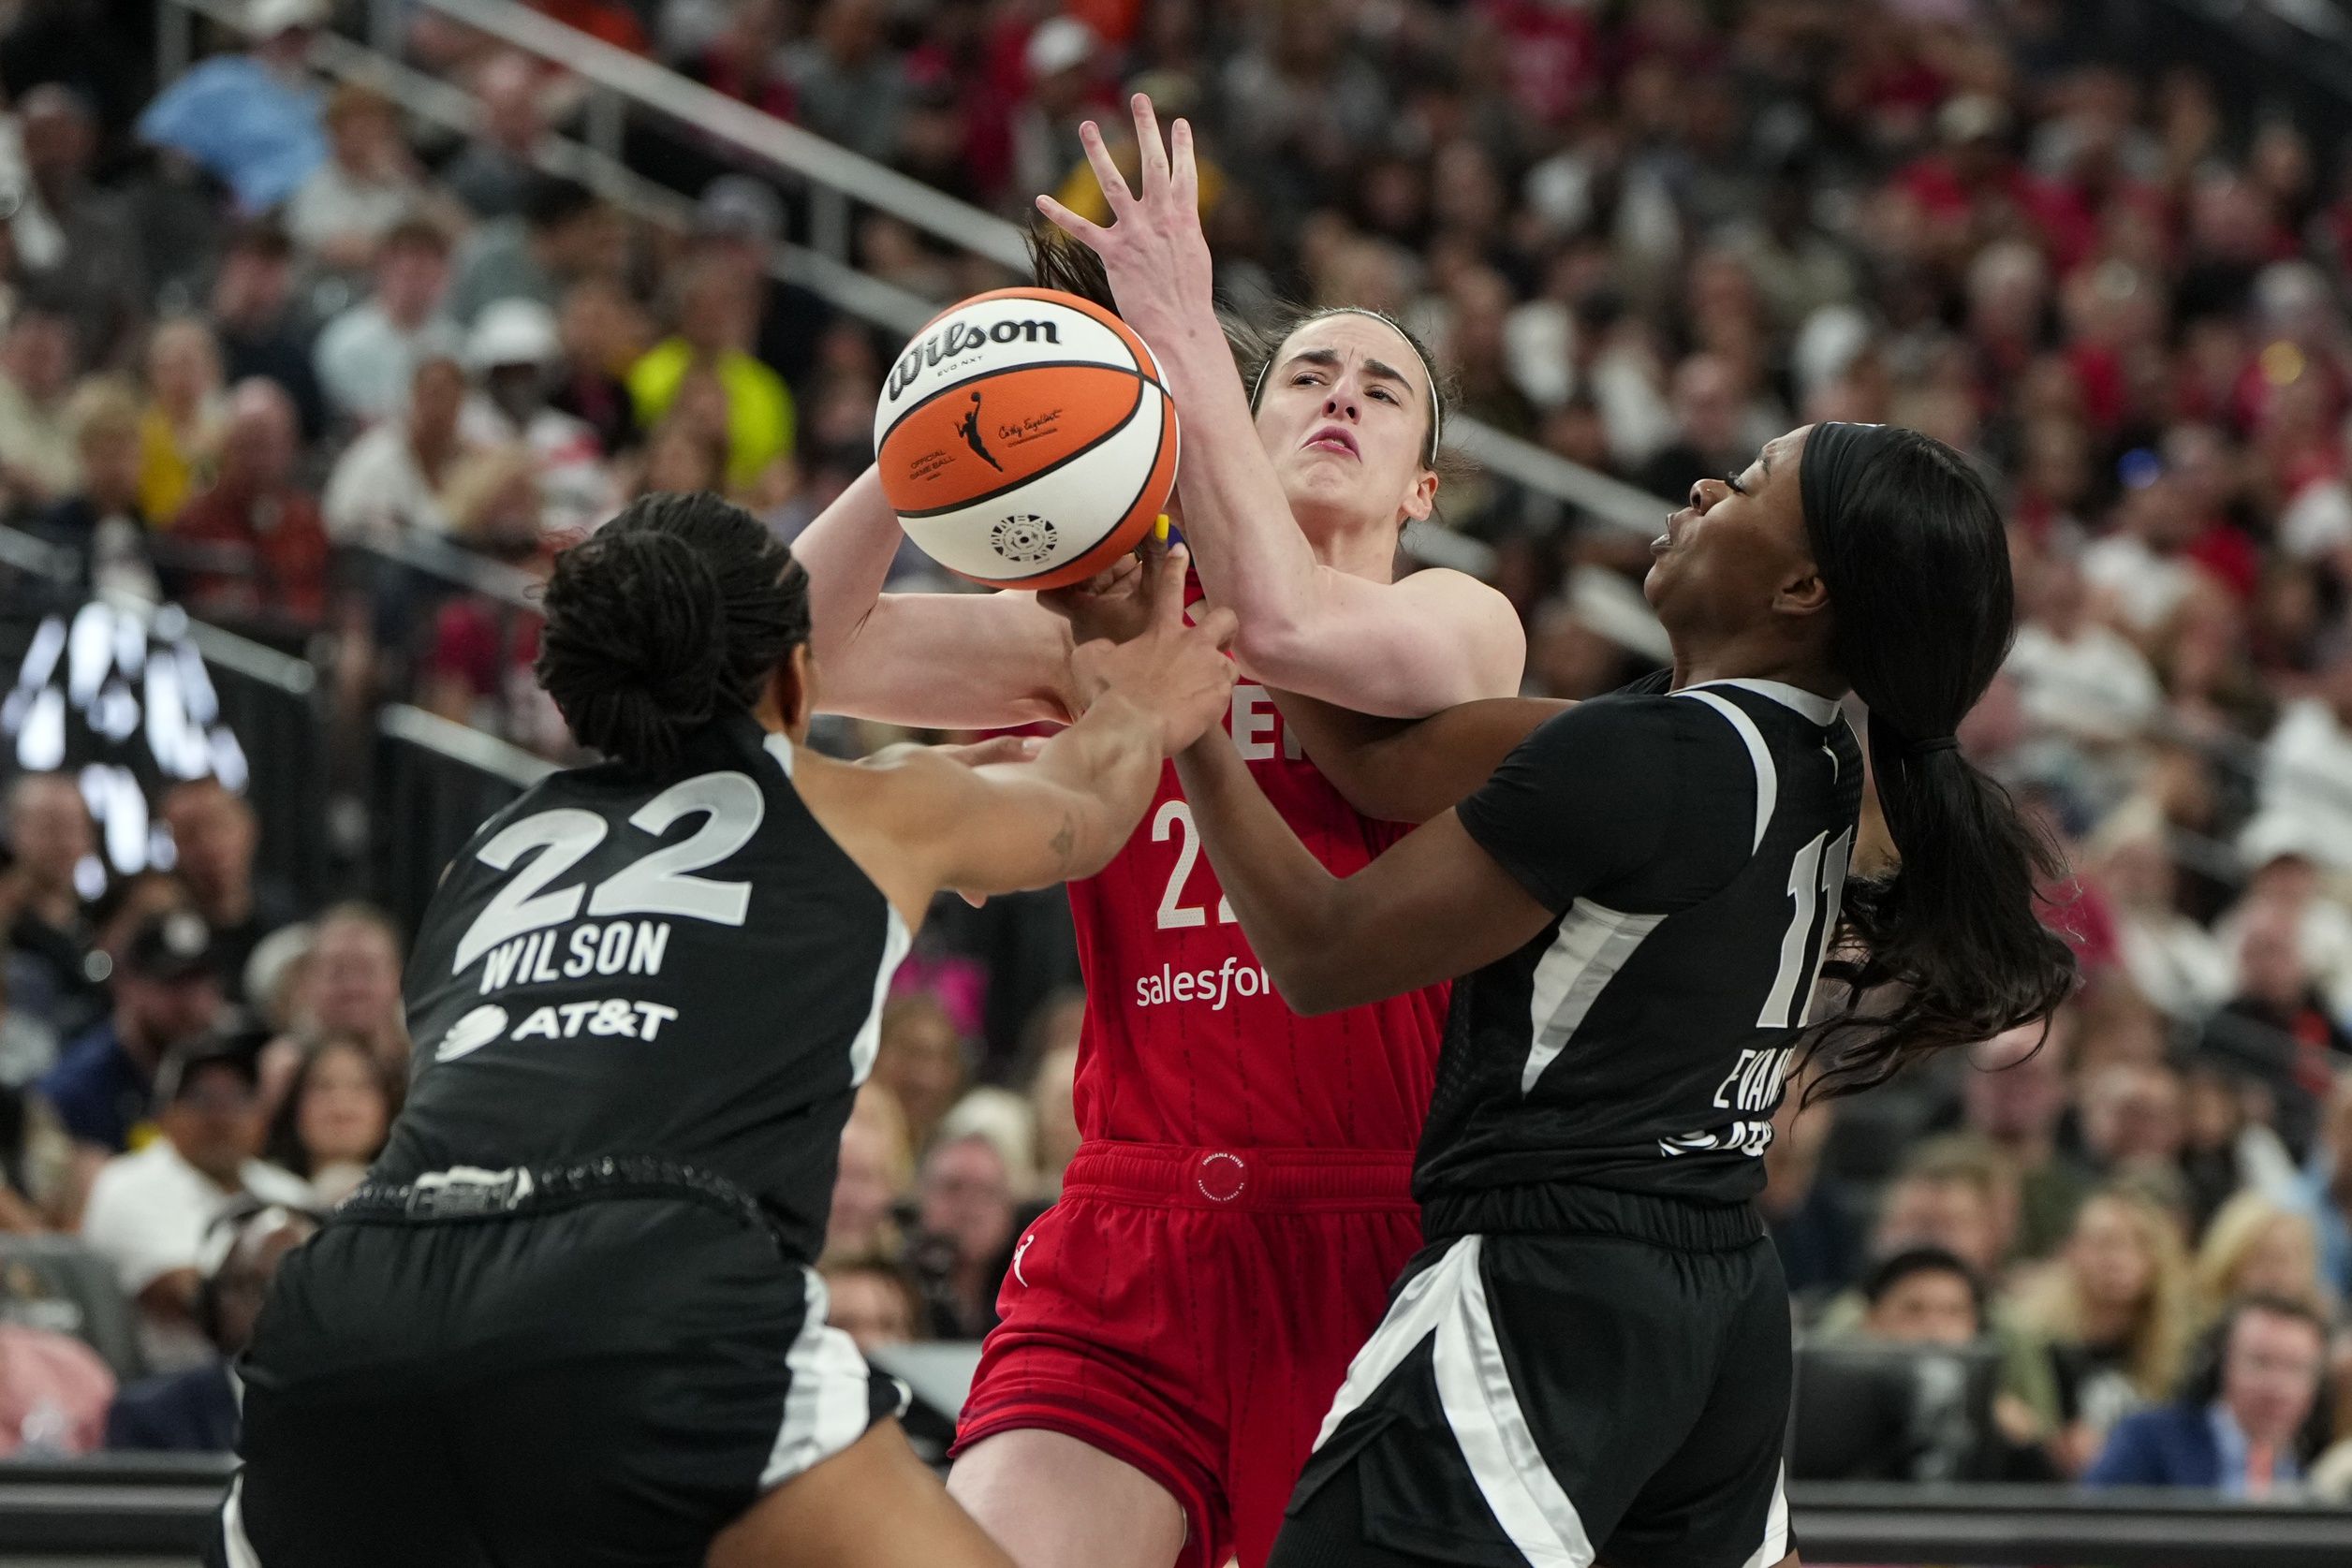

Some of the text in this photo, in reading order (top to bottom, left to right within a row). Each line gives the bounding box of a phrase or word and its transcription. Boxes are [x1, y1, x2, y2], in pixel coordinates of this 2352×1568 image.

[889, 319, 1062, 402] Wilson
[909, 465, 933, 480] GAME
[932, 456, 956, 469] BALL
[910, 449, 946, 469] OFFICIAL
[452, 770, 765, 976] 22
[1152, 800, 1240, 931] 2
[478, 920, 670, 996] WILSON
[1756, 824, 1853, 1029] 11
[510, 998, 679, 1043] AT&T
[1713, 1045, 1797, 1112] EVAN
[1202, 1152, 1244, 1168] INDIANA FEVER
